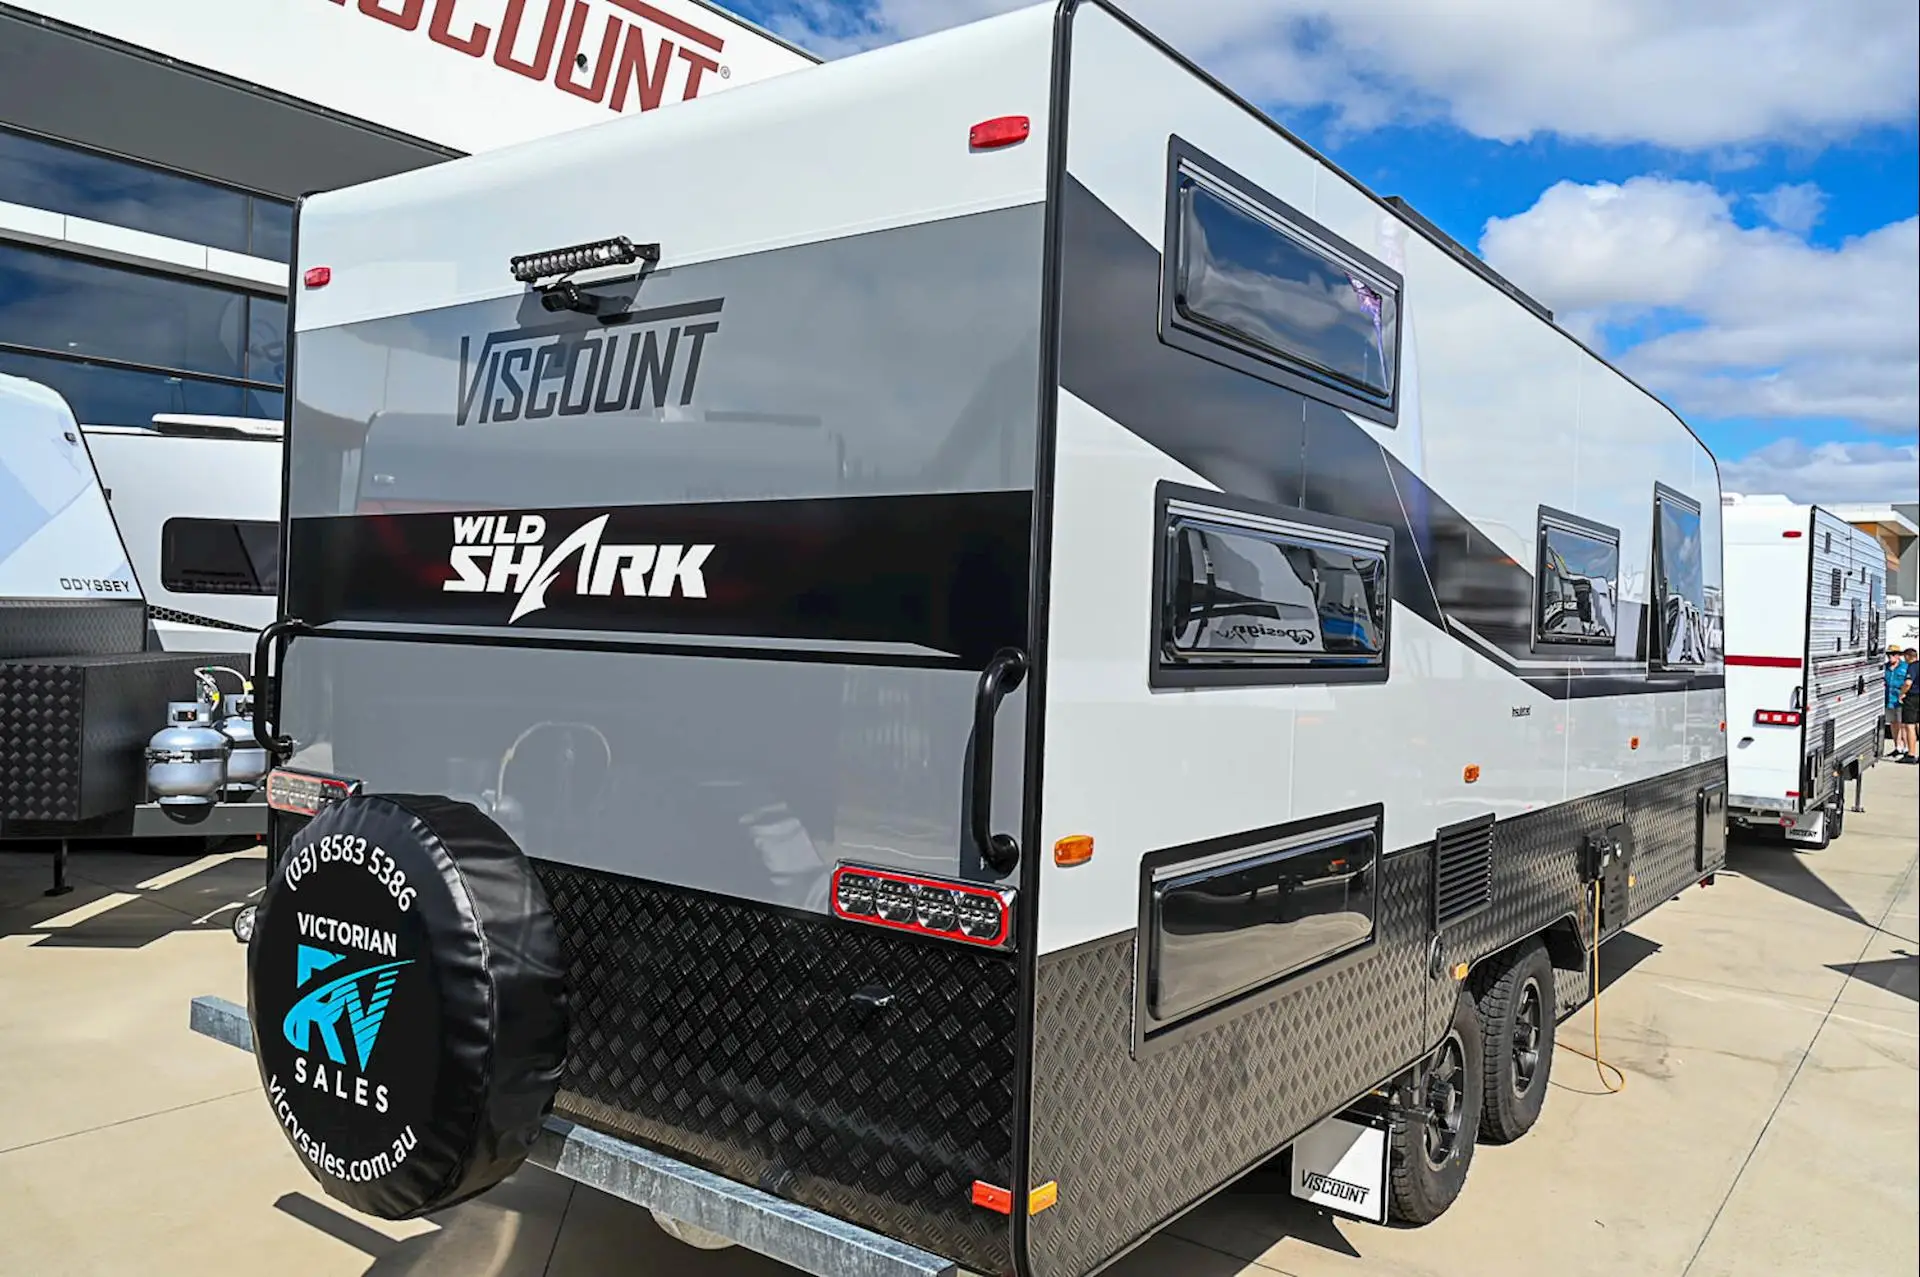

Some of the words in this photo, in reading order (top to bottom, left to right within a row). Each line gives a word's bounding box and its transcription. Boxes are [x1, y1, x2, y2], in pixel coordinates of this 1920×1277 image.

[456, 297, 725, 426] VISCOUNT
[453, 514, 546, 544] WILD
[60, 578, 130, 592] ODYSSEY
[443, 513, 716, 624] SHARK
[285, 845, 317, 891] (03)
[320, 834, 367, 866] 8583
[368, 846, 417, 912] 5386
[297, 911, 397, 958] VICTORIAN
[294, 1057, 389, 1114] SALES
[268, 1073, 418, 1183] vicrvsales.com.au
[1301, 1169, 1370, 1205] VISCOUNT
